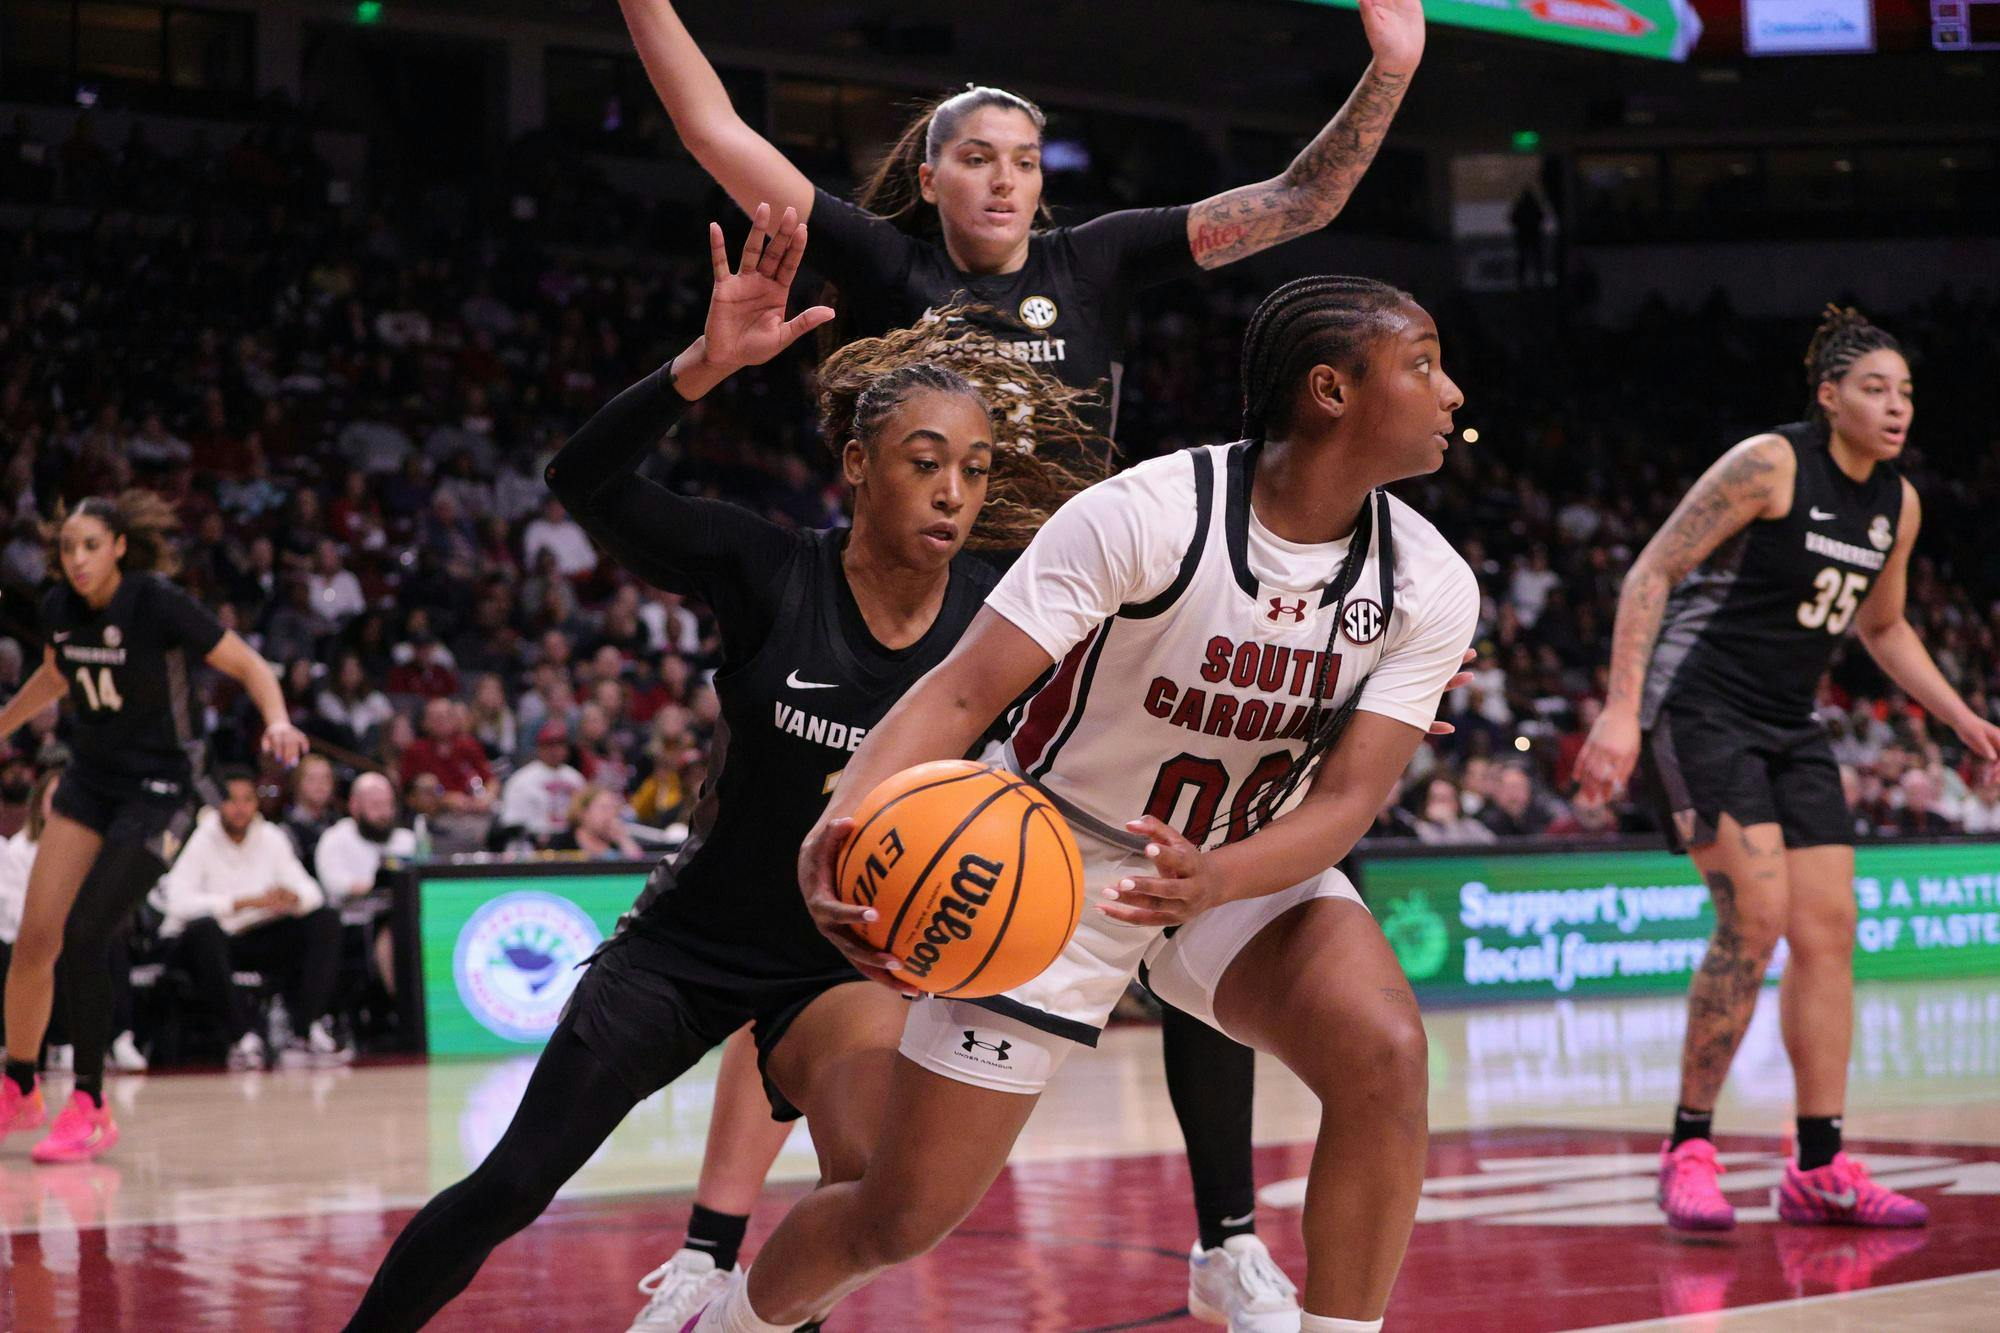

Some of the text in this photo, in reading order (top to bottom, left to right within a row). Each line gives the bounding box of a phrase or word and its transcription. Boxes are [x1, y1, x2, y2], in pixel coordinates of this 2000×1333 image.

[1342, 601, 1385, 643] SEC
[1796, 566, 1868, 635] 35
[75, 665, 124, 712] 14
[1200, 635, 1342, 700] SOUTH
[774, 700, 872, 753] VANDE
[1143, 675, 1333, 744] CAROLIN
[904, 852, 1004, 977] Wilson
[1459, 881, 1711, 938] Support your
[1888, 878, 1914, 910] A
[1463, 932, 1560, 985] local
[1857, 916, 1903, 953] OF
[954, 1050, 1013, 1071] UNDER ARMOUR
